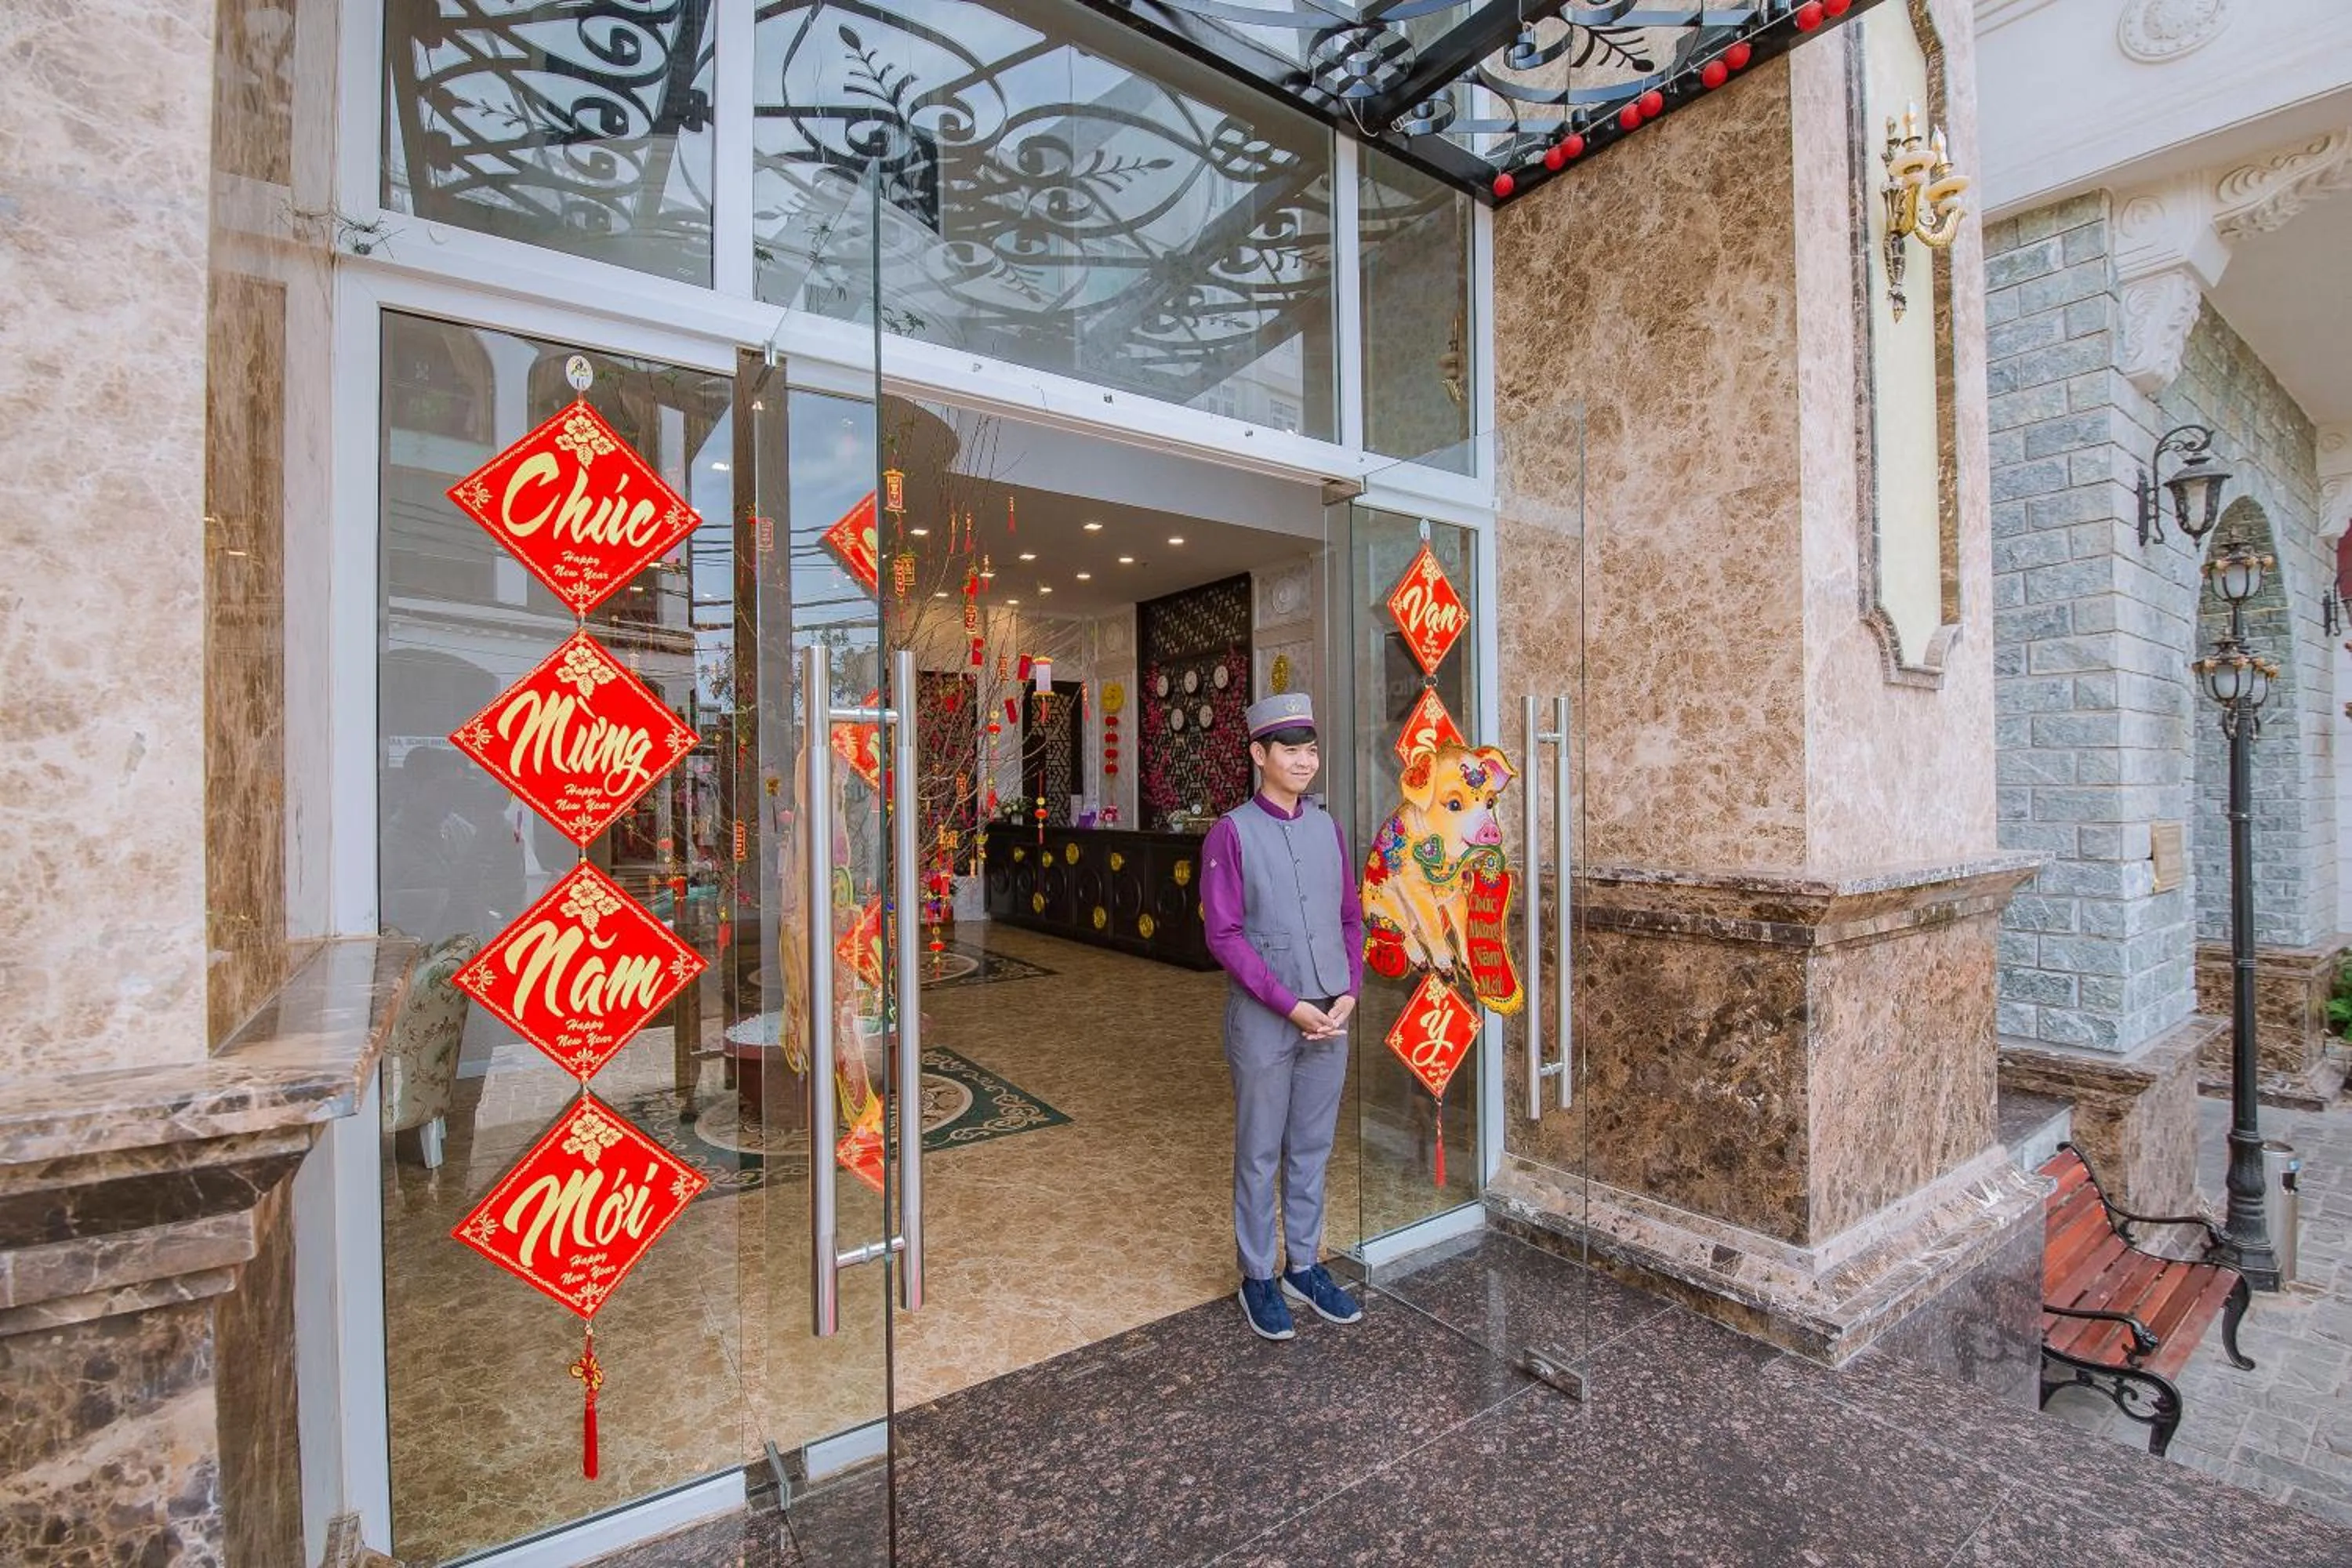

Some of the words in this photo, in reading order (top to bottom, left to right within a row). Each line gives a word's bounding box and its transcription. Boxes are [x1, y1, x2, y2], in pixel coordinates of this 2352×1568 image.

[502, 452, 662, 547] Chúc
[561, 550, 600, 567] Happy
[552, 564, 579, 577] New
[583, 567, 609, 581] Year
[497, 690, 653, 797] Mừng
[564, 783, 603, 798] Happy
[555, 799, 580, 811] New
[585, 798, 612, 812] Year
[504, 920, 665, 1020] Năm
[566, 1018, 604, 1033] Happy
[556, 1034, 582, 1047] New
[586, 1032, 612, 1047] Year
[503, 1162, 659, 1267] Mới
[569, 1252, 608, 1269] Happy
[561, 1272, 586, 1285] New
[590, 1264, 617, 1280] Year
